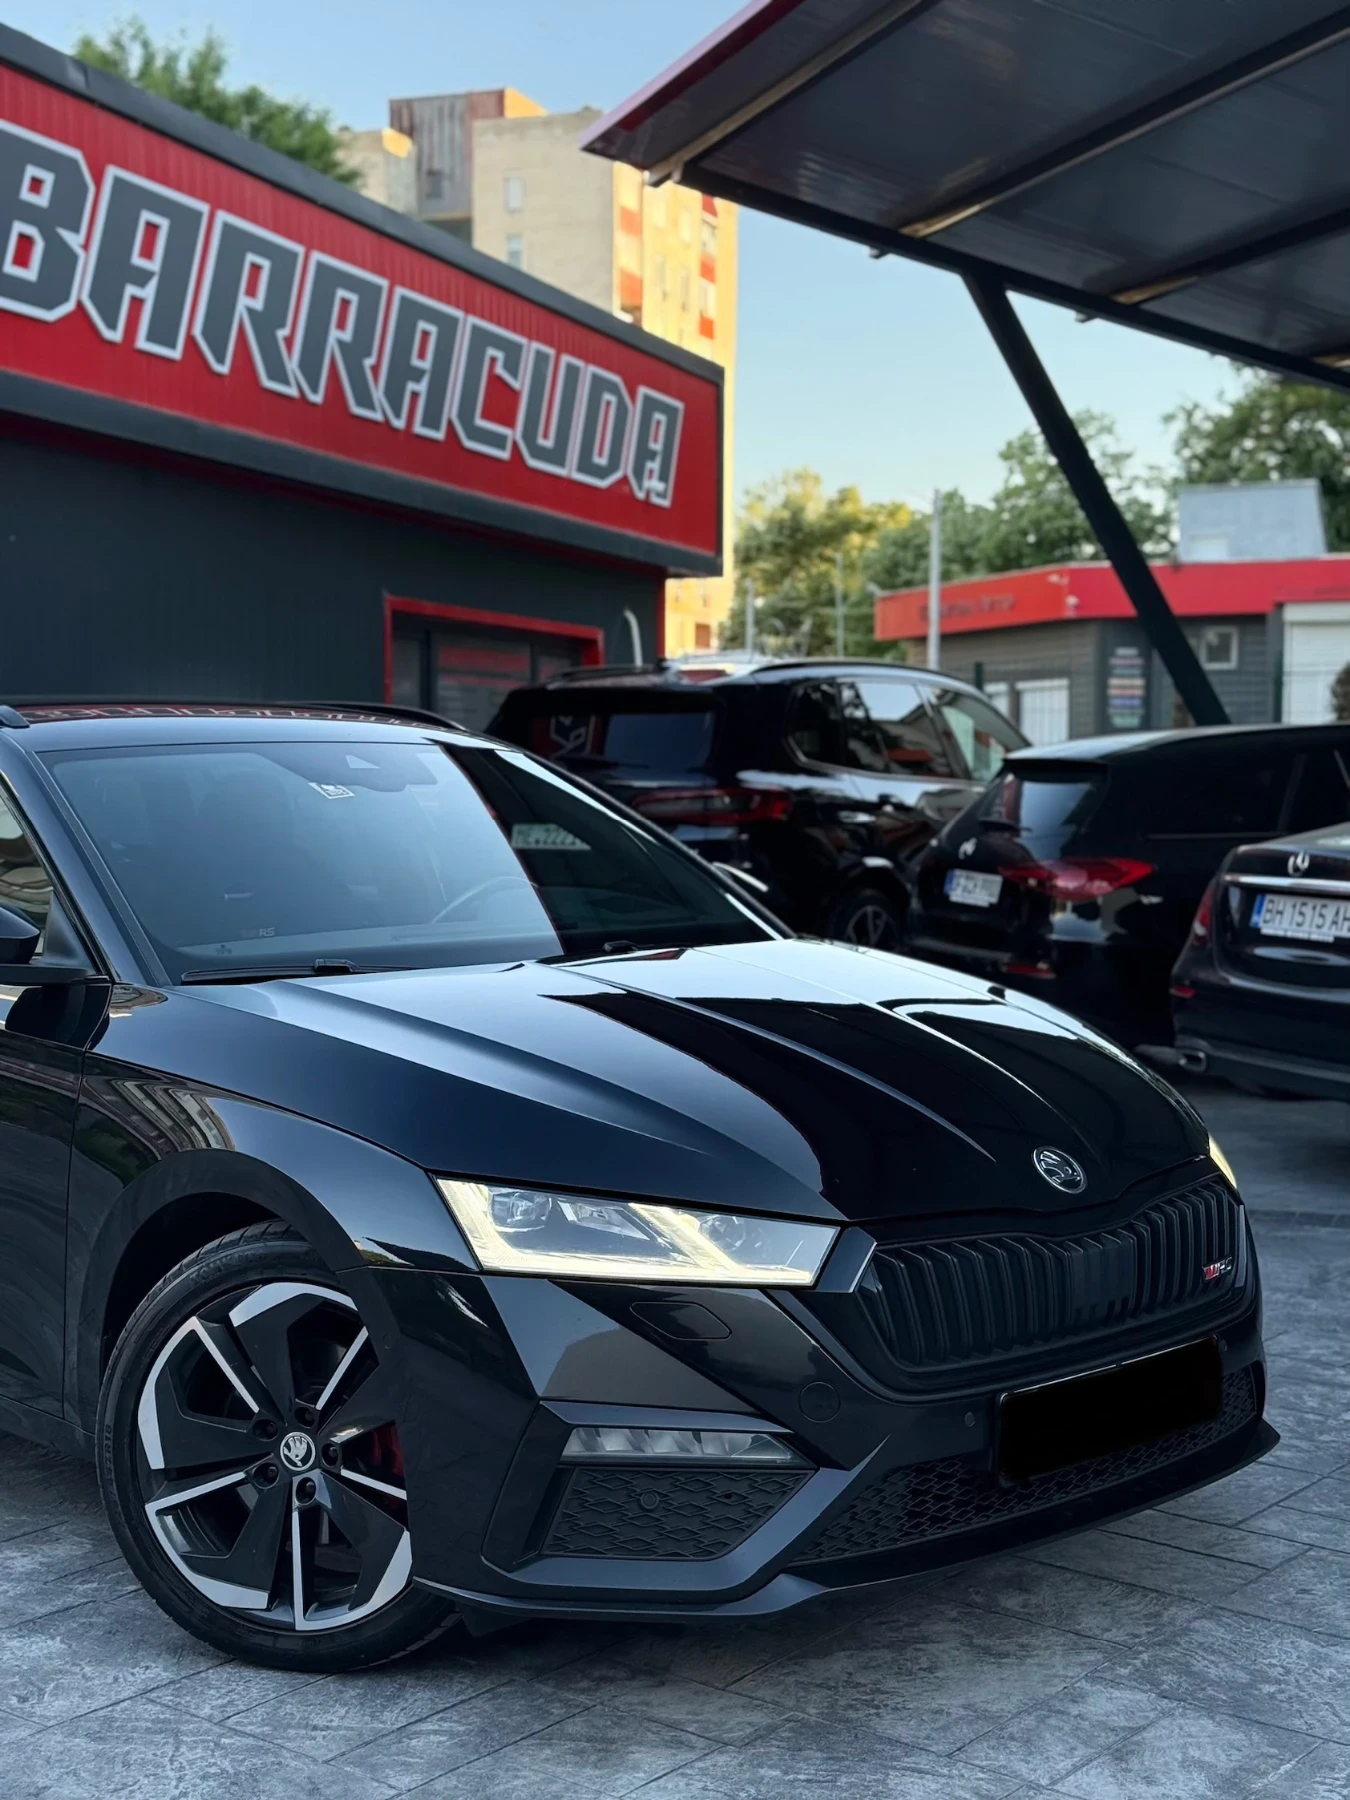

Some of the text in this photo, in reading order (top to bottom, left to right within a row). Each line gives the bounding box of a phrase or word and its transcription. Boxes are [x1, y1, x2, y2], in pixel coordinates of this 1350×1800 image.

[0, 118, 685, 508] BARRACUDA
[1263, 899, 1288, 925] BH
[1290, 901, 1328, 929] 1515
